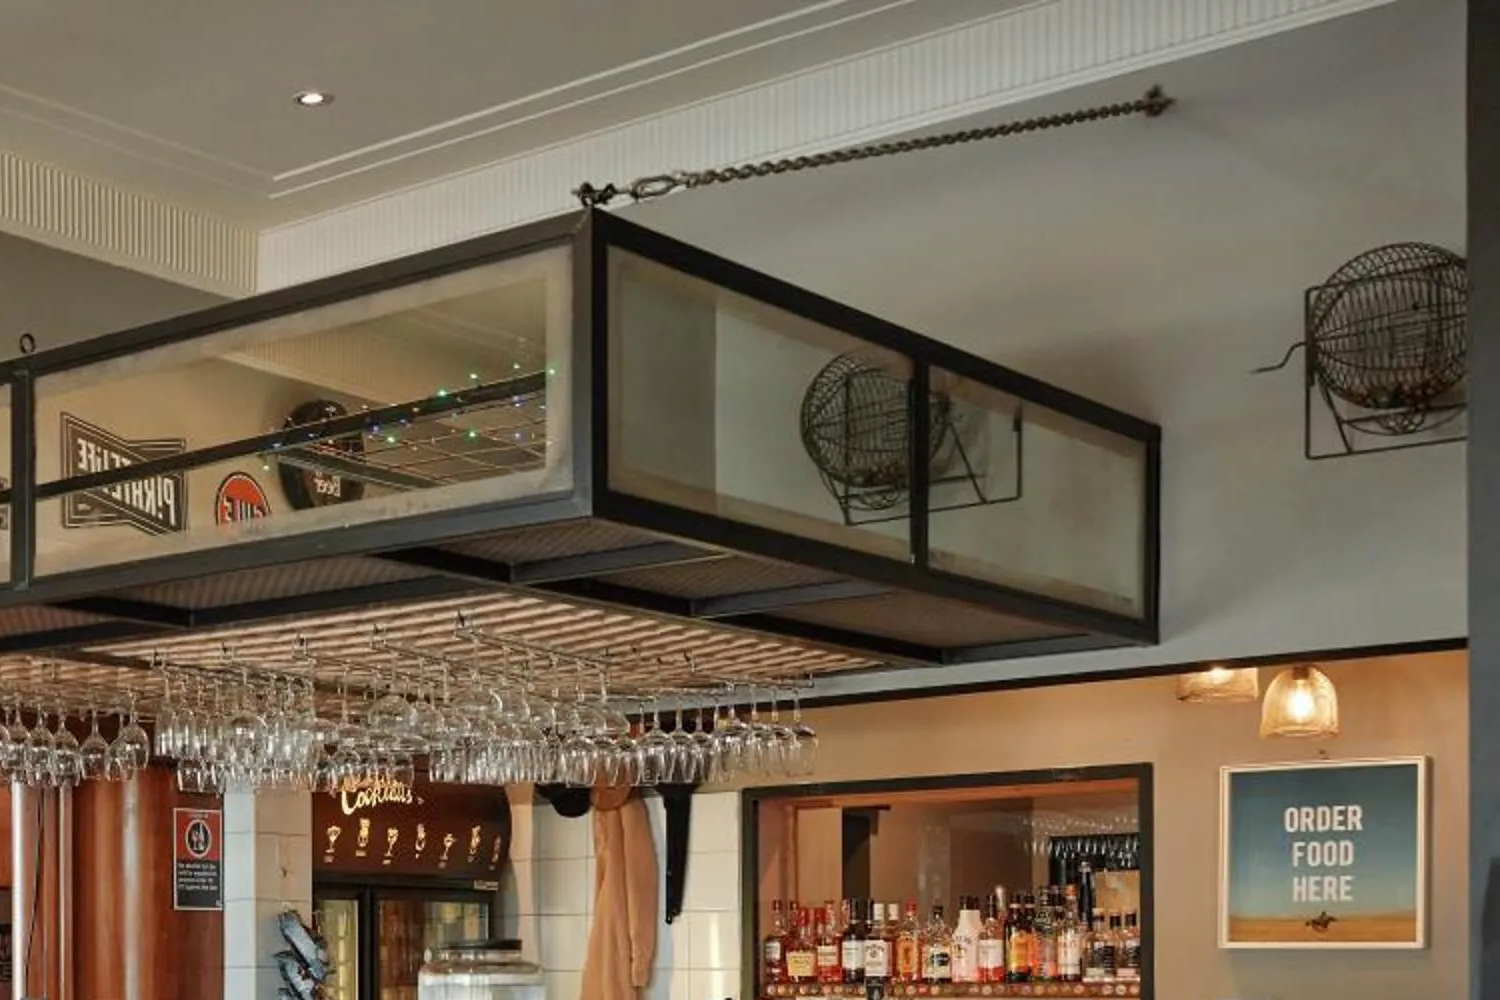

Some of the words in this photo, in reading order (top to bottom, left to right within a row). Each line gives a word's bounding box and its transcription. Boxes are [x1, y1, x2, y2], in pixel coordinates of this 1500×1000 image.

[1283, 804, 1363, 833] ORDER
[1292, 839, 1355, 868] FOOD
[1292, 874, 1355, 903] HERE
